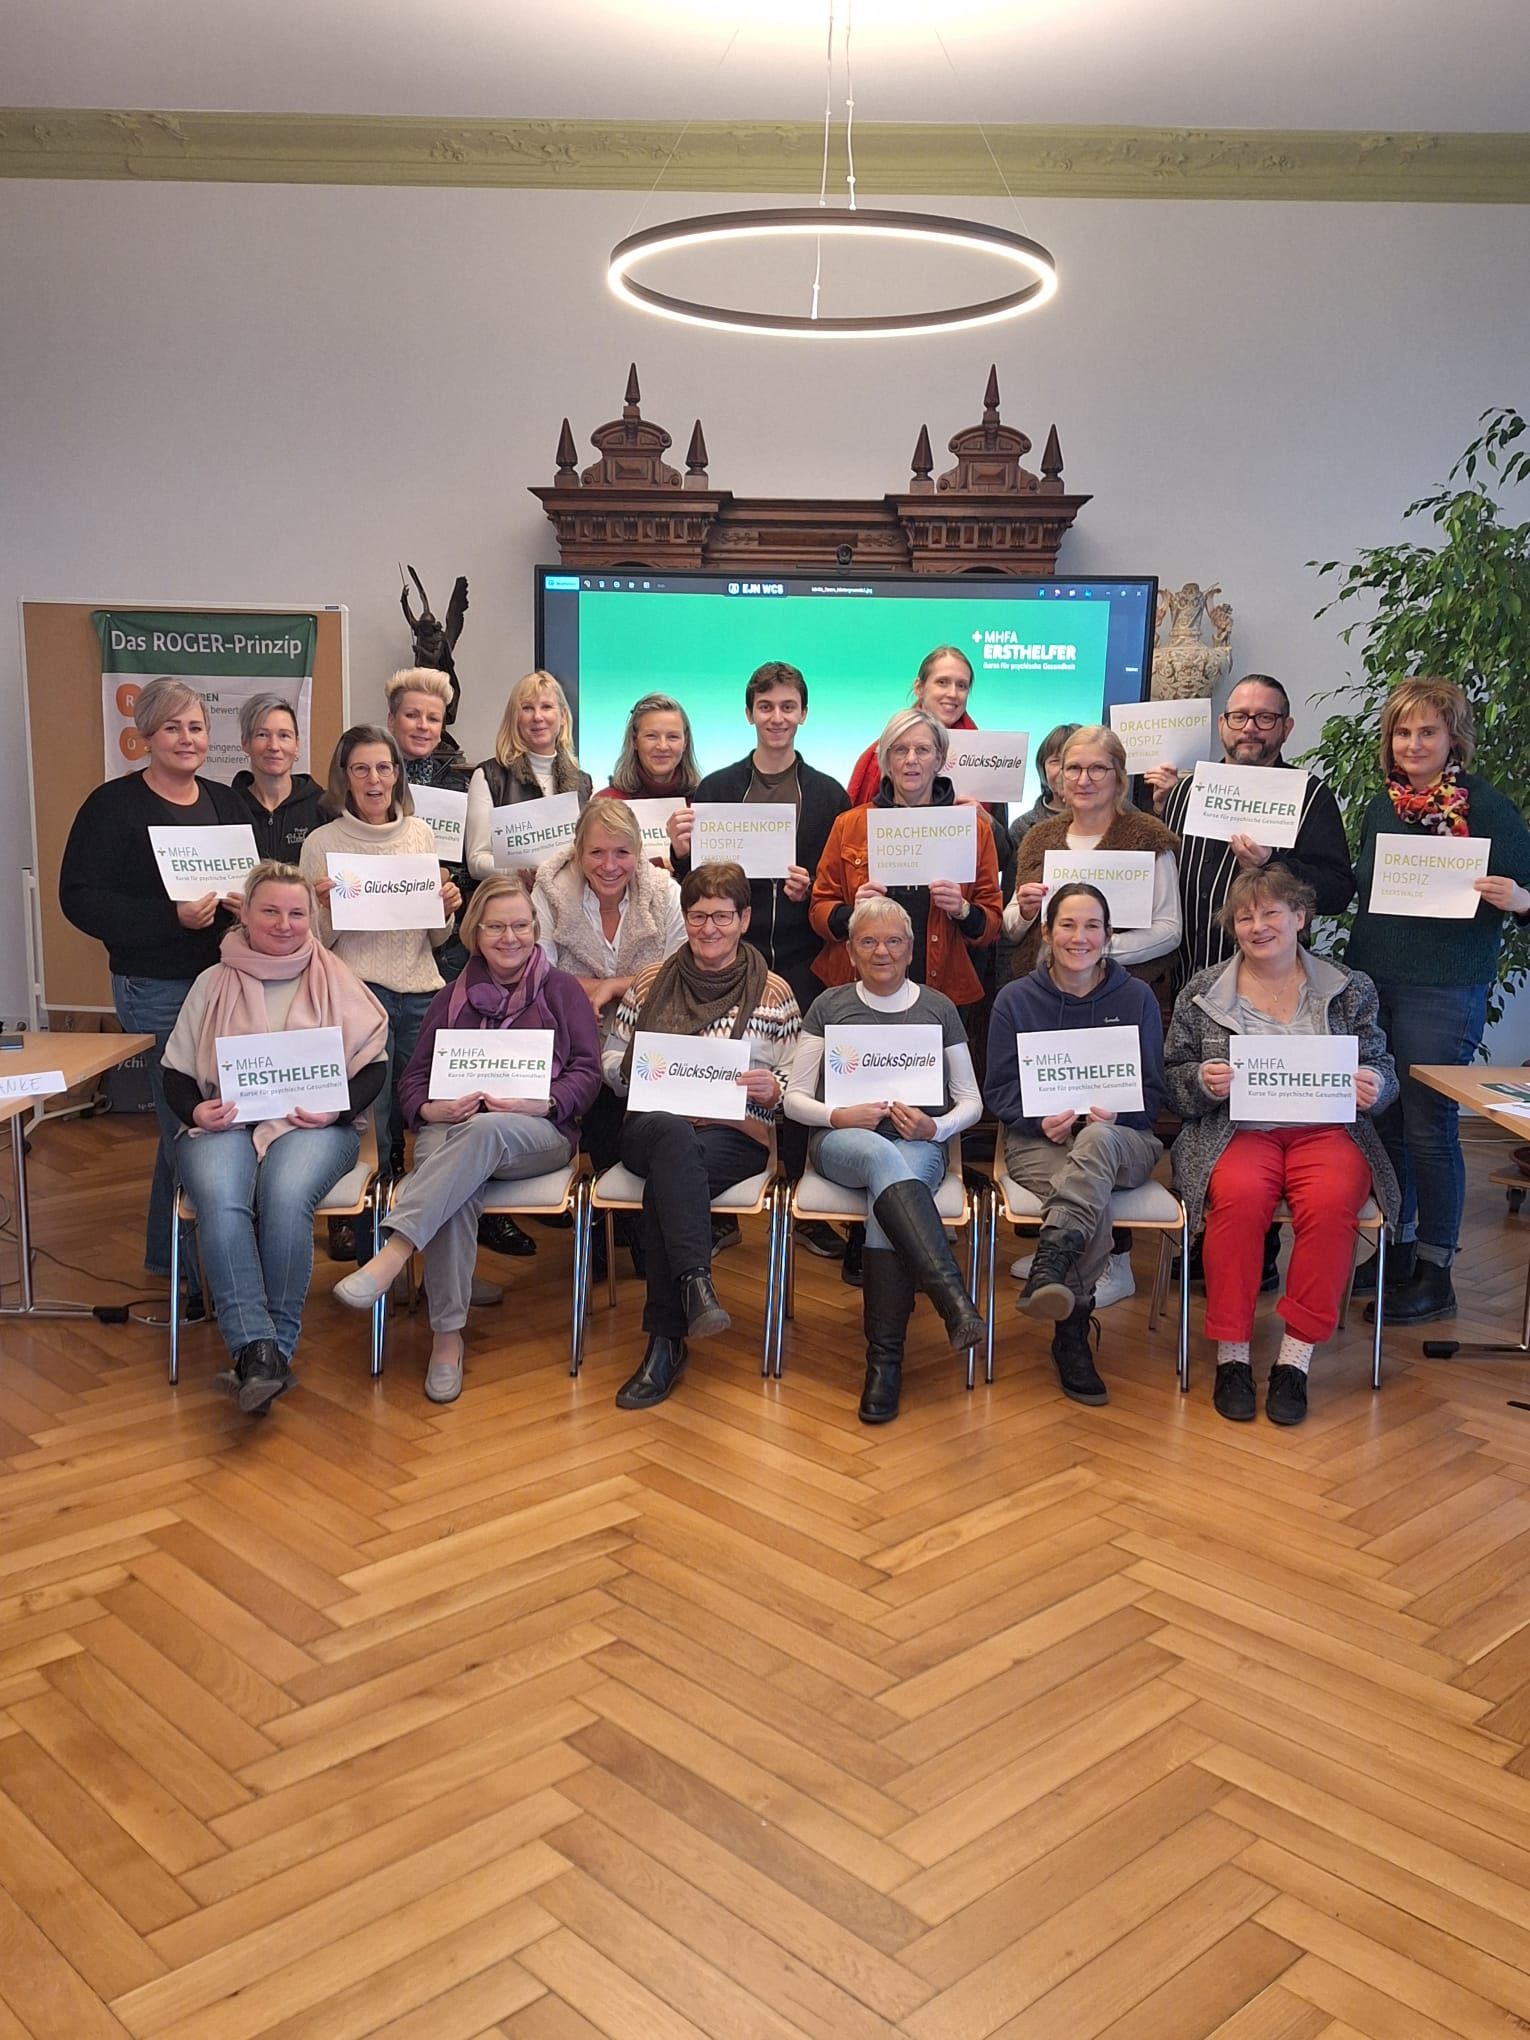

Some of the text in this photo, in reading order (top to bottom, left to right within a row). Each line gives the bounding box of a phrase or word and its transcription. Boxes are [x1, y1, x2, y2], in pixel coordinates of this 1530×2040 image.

[984, 630, 1018, 643] MHFA
[111, 630, 302, 660] Das ROGER-Prinzip
[983, 643, 1076, 660] ERSTHELFER
[210, 705, 241, 715] bewert
[1120, 716, 1208, 732] DRACHENKOPF
[958, 754, 1022, 771] GlücksSpirale
[1207, 783, 1240, 796] MHFA
[1204, 796, 1296, 817] ERSTHELFER
[422, 817, 461, 834] ELFER
[505, 821, 533, 835] MHFA
[700, 821, 792, 833] DRACHENKOPF
[876, 825, 972, 839] DRACHENKOPF
[700, 838, 744, 850] HOSPIZ
[876, 844, 923, 856] HOSPIZ
[168, 846, 199, 857] MHFA
[171, 857, 255, 872] ERSTHELFER
[1385, 853, 1483, 871] DRACHENKOPF
[1052, 868, 1150, 881] DRACHENKOPF
[1382, 872, 1430, 886] HOSPIZ
[364, 878, 436, 896] GlücksSpirale
[450, 1048, 485, 1057] MHFA
[1036, 1053, 1072, 1066] MHFA
[236, 1056, 274, 1071] MHFA
[448, 1058, 546, 1071] ERSTHELFER
[862, 1052, 936, 1071] GlücksSpirale
[1247, 1058, 1285, 1070] MHFA
[238, 1063, 341, 1087] ERSTHELFER
[668, 1062, 742, 1083] GlücksSpirale
[1037, 1063, 1136, 1082] ERSTHELFER
[1248, 1072, 1352, 1087] ERSTHELFER
